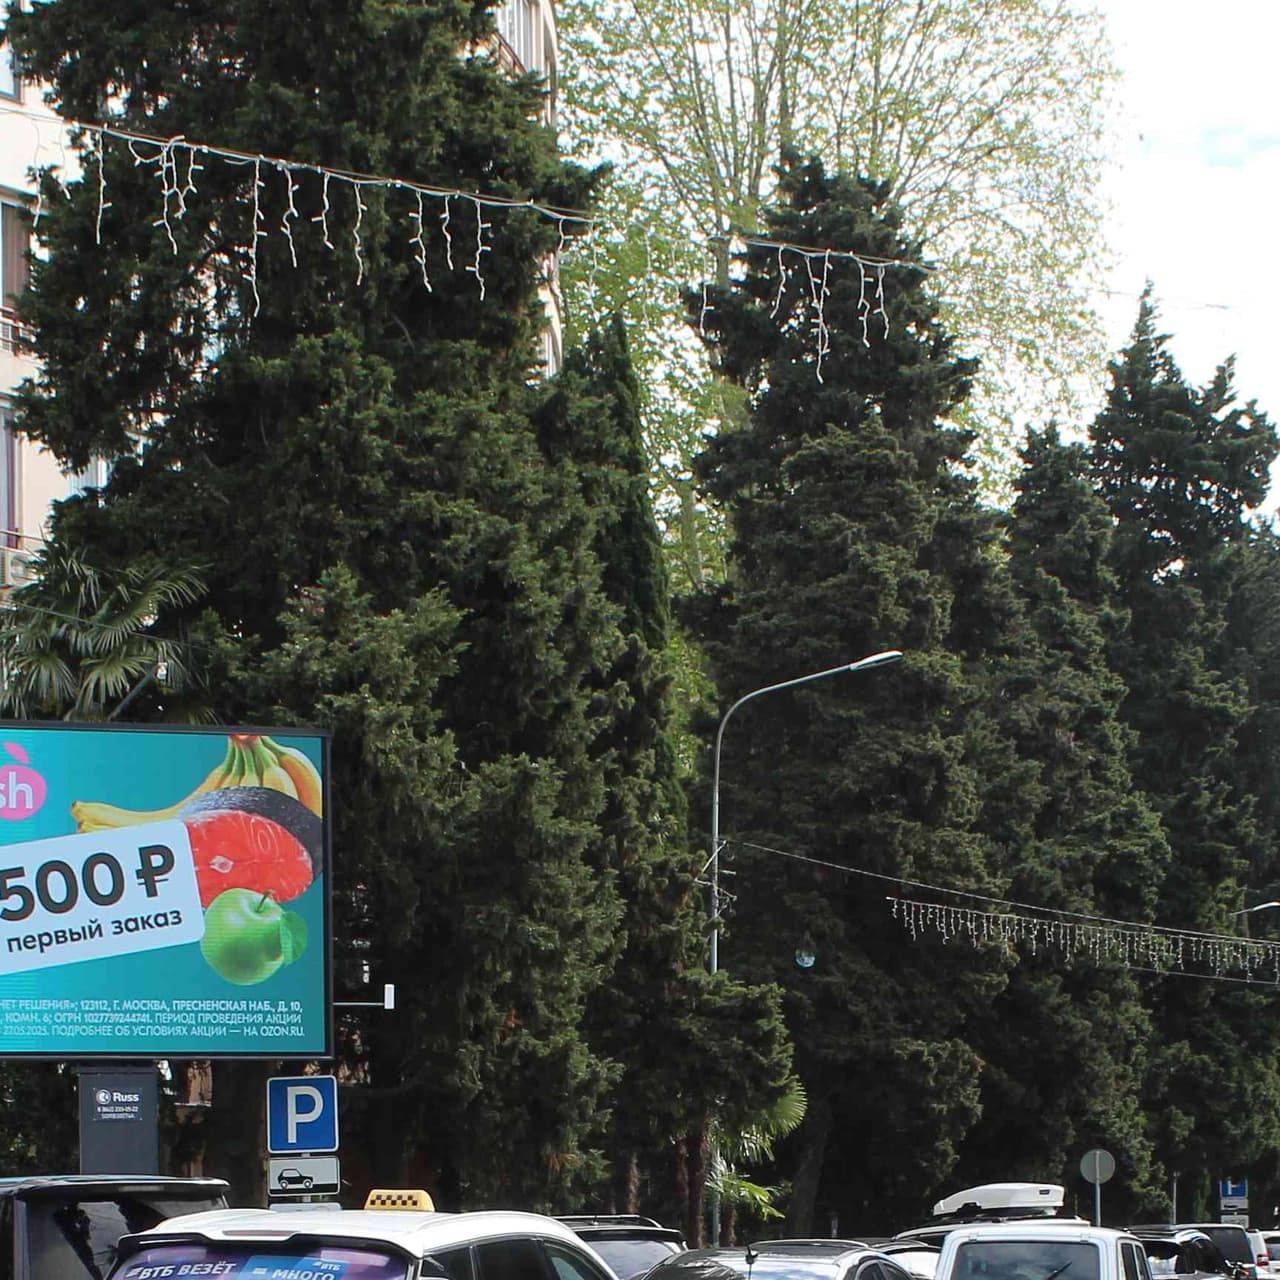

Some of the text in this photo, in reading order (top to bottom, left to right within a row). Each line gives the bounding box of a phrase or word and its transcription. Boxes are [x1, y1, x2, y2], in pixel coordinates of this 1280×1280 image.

[7, 918, 104, 953] первый
[111, 909, 183, 935] заказ
[122, 1000, 170, 1013] МОСКВА,
[173, 1001, 247, 1011] ПРЕСНЕНСКАЯ
[54, 1013, 81, 1023] ОГРН
[155, 1013, 195, 1025] ПЕРИОД
[198, 1013, 263, 1025] ПРОВЕДЕНИЯ
[265, 1013, 302, 1025] АКЦИИ
[51, 1026, 112, 1038] ПОДРОБНЕЕ
[115, 1026, 130, 1036] ОБ
[132, 1026, 188, 1037] УСЛОВИЯХ
[190, 1026, 227, 1038] АКЦИИ
[243, 1026, 258, 1036] НА
[112, 1091, 140, 1103] Russ
[138, 1261, 237, 1280] ВТБ ВЕЗЁТ
[320, 1263, 341, 1271] ВТБ
